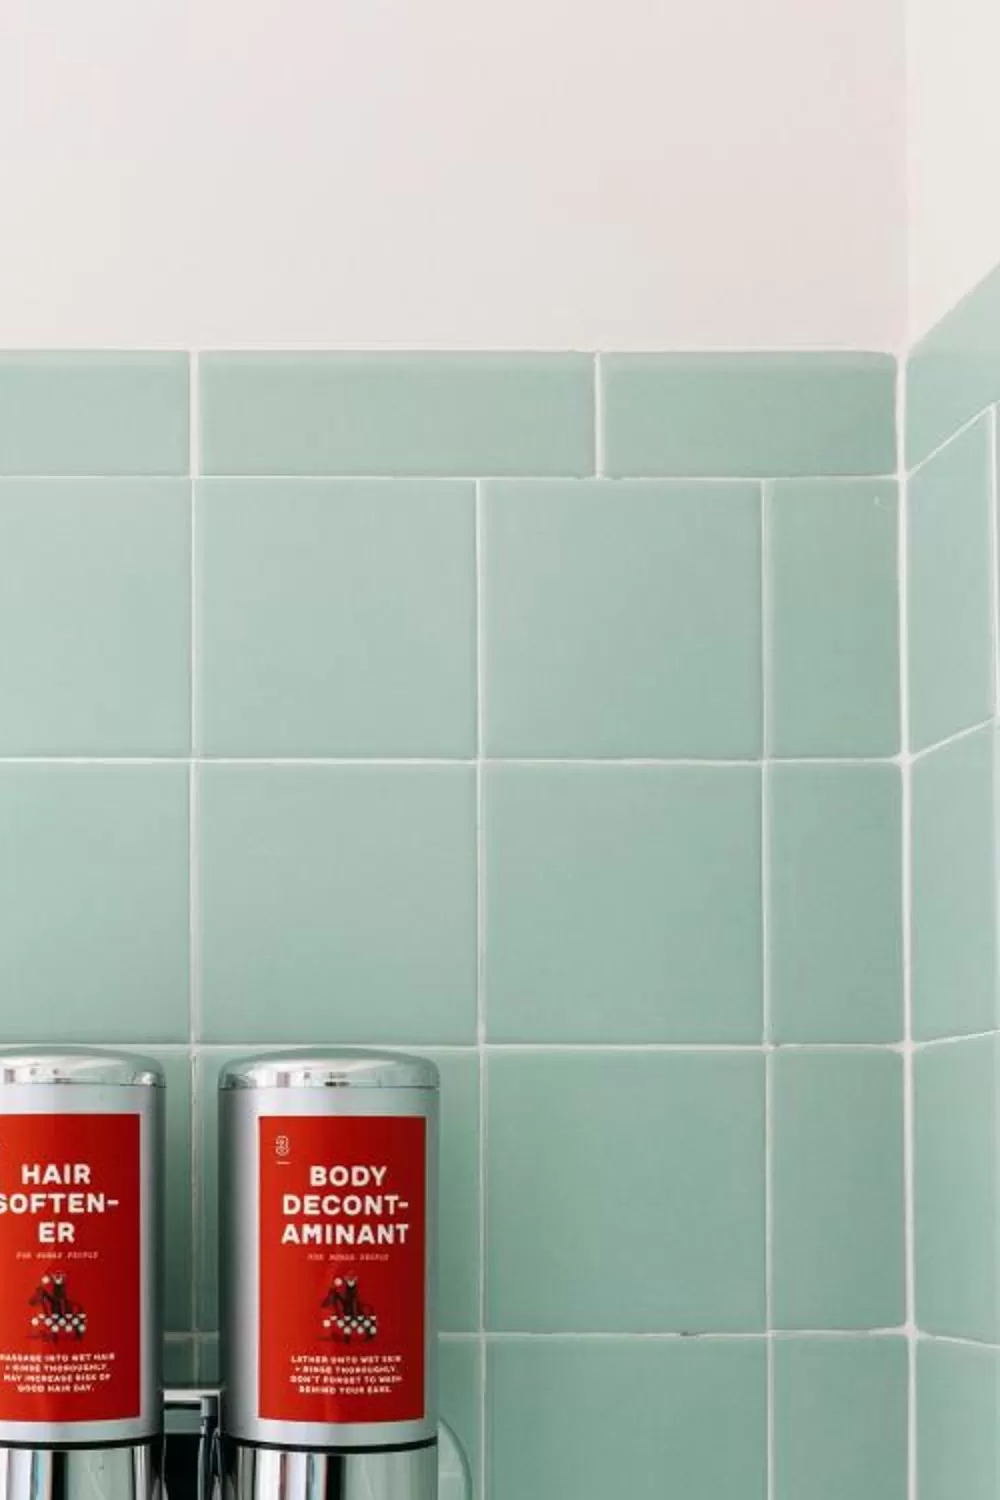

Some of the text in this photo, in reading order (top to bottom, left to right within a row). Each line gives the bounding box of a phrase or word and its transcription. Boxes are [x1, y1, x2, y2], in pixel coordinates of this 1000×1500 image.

[275, 1135, 289, 1156] 3
[21, 1163, 91, 1185] HAIR
[310, 1165, 388, 1187] BODY
[282, 1194, 409, 1216] DECONT-
[38, 1222, 75, 1243] ER
[281, 1223, 409, 1245] AMINANT
[47, 1383, 71, 1392] HAIR
